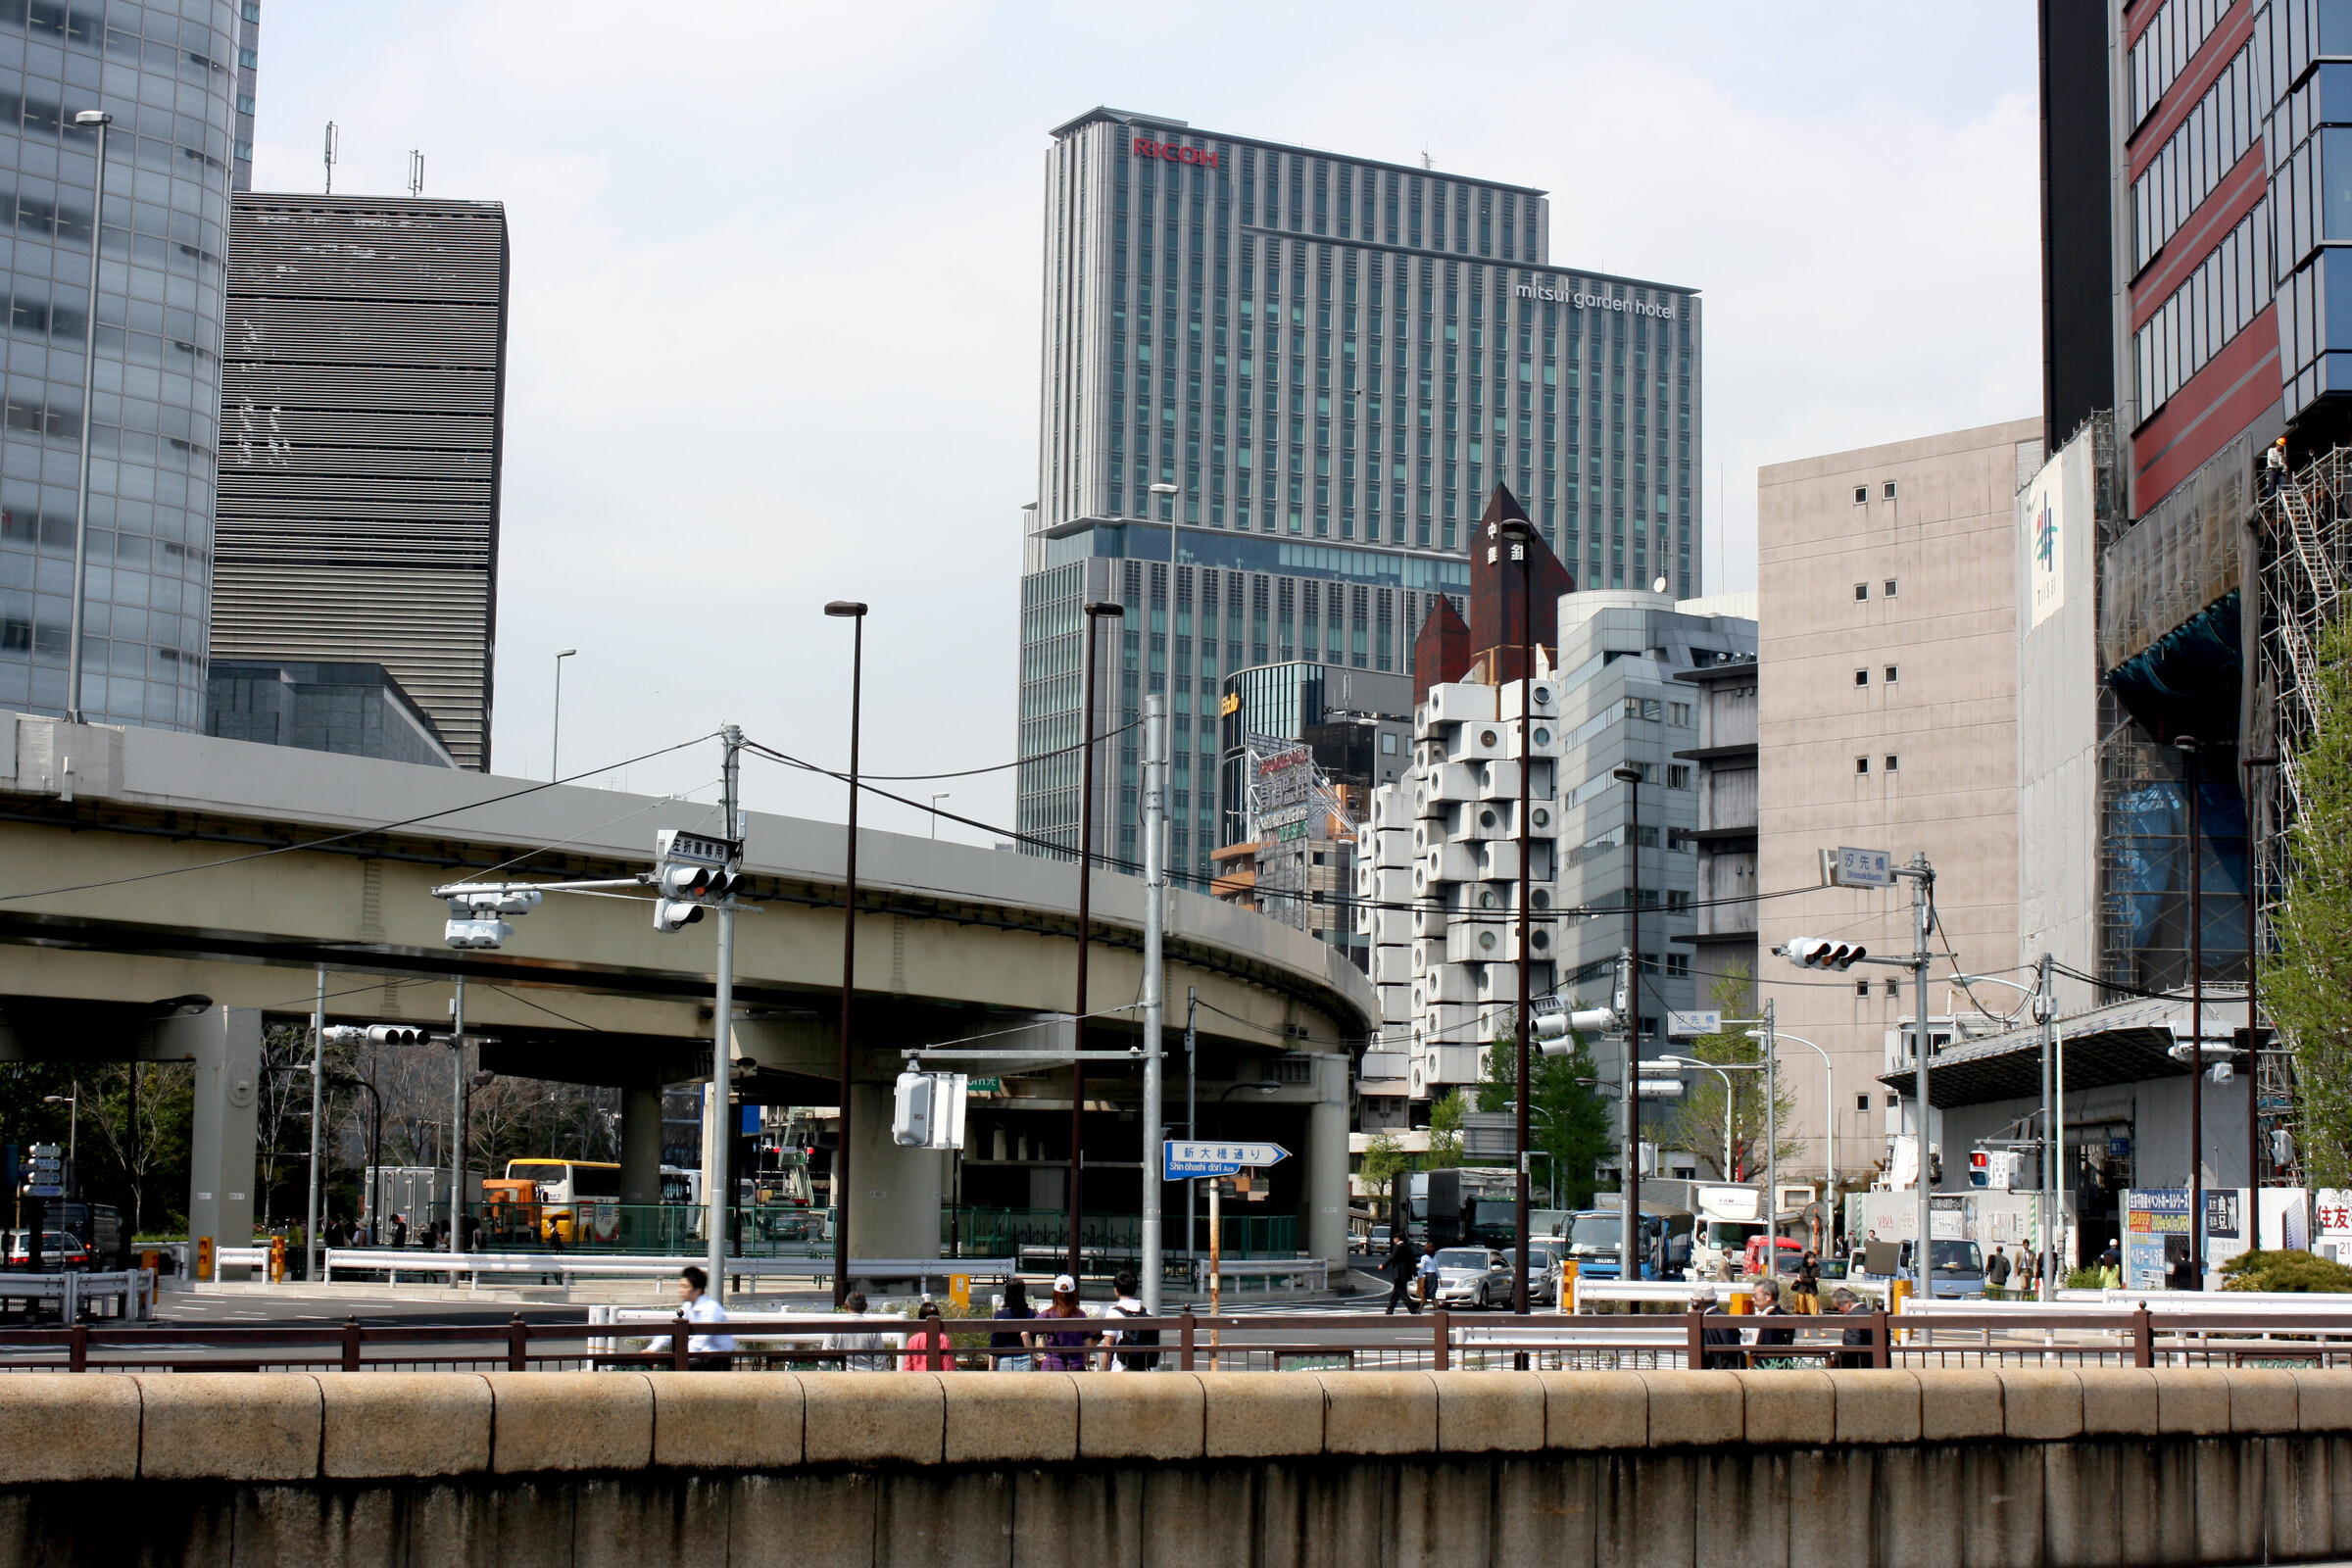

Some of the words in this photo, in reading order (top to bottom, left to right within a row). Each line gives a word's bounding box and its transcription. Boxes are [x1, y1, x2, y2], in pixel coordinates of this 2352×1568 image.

[1134, 137, 1218, 168] RICOH
[1516, 274, 1569, 303] mitsui
[1574, 285, 1632, 312] garden
[1636, 300, 1676, 320] hotel
[672, 839, 723, 859] 左折車専用
[1844, 853, 1886, 871] 汐先橋
[1184, 1148, 1260, 1160] 新大橋通り
[2317, 1204, 2352, 1229] 住友
